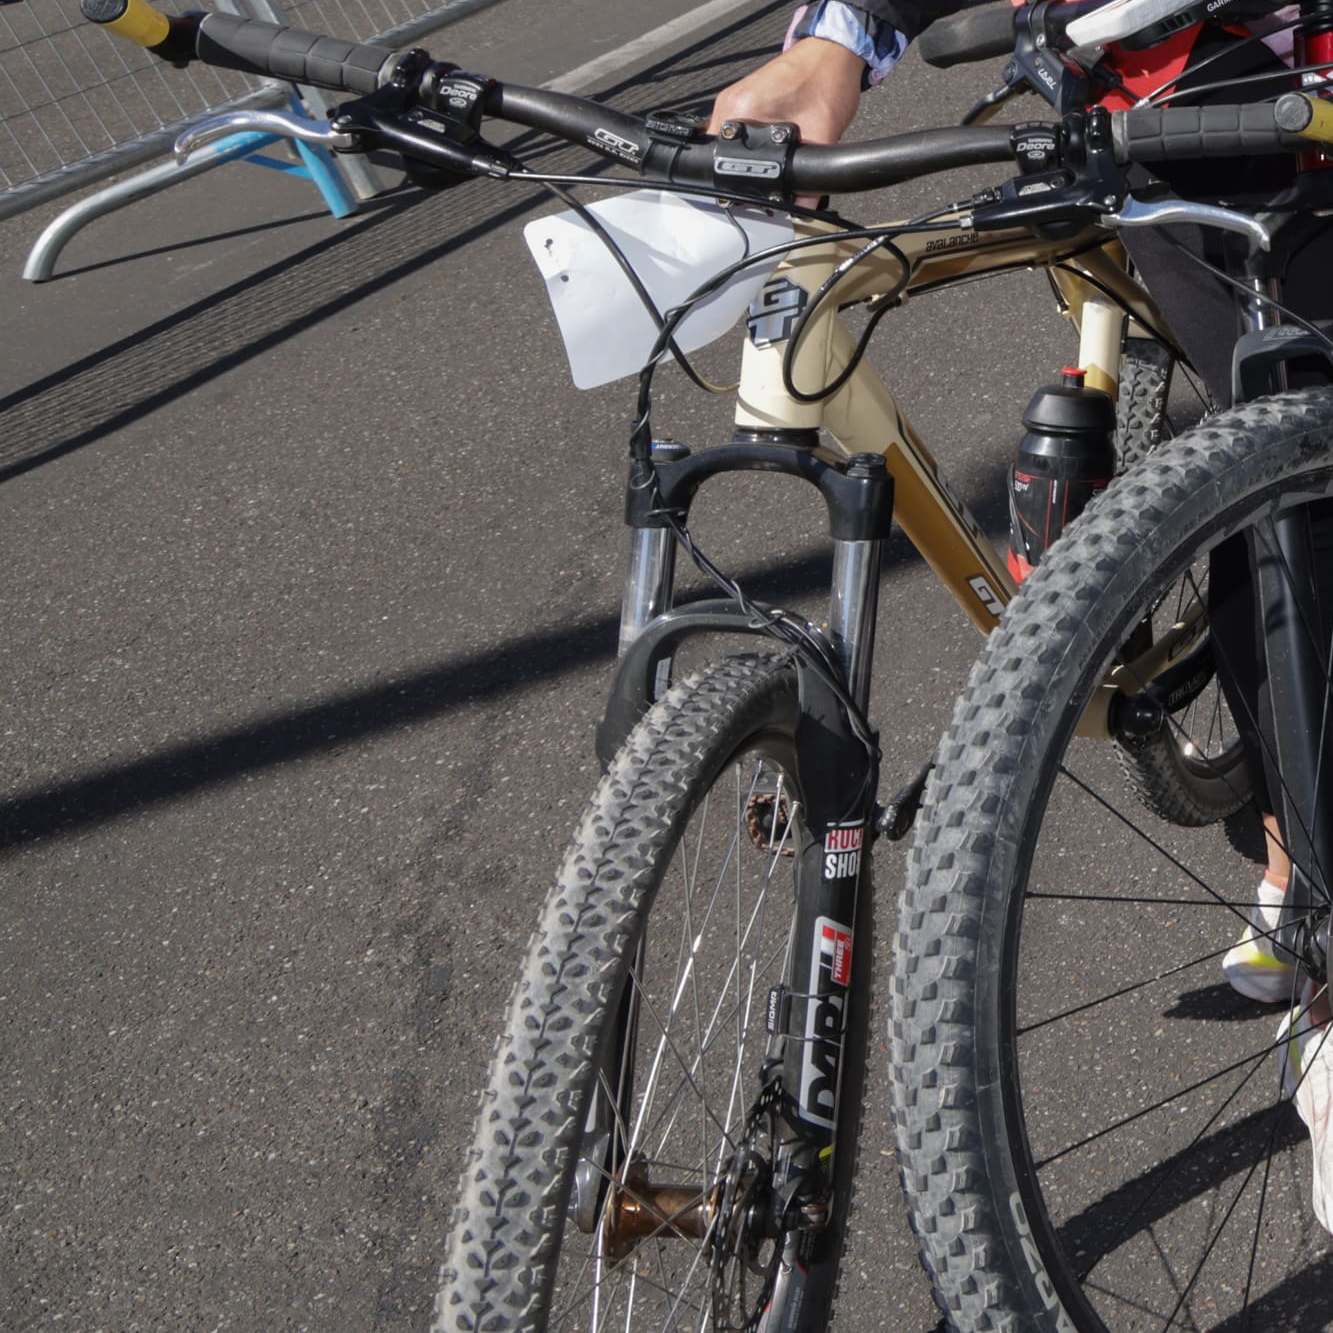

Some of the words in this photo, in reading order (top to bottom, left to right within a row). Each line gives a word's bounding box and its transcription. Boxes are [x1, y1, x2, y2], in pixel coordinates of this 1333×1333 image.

[440, 85, 478, 101] Deore
[1016, 142, 1056, 152] Deore
[832, 939, 848, 981] THREE
